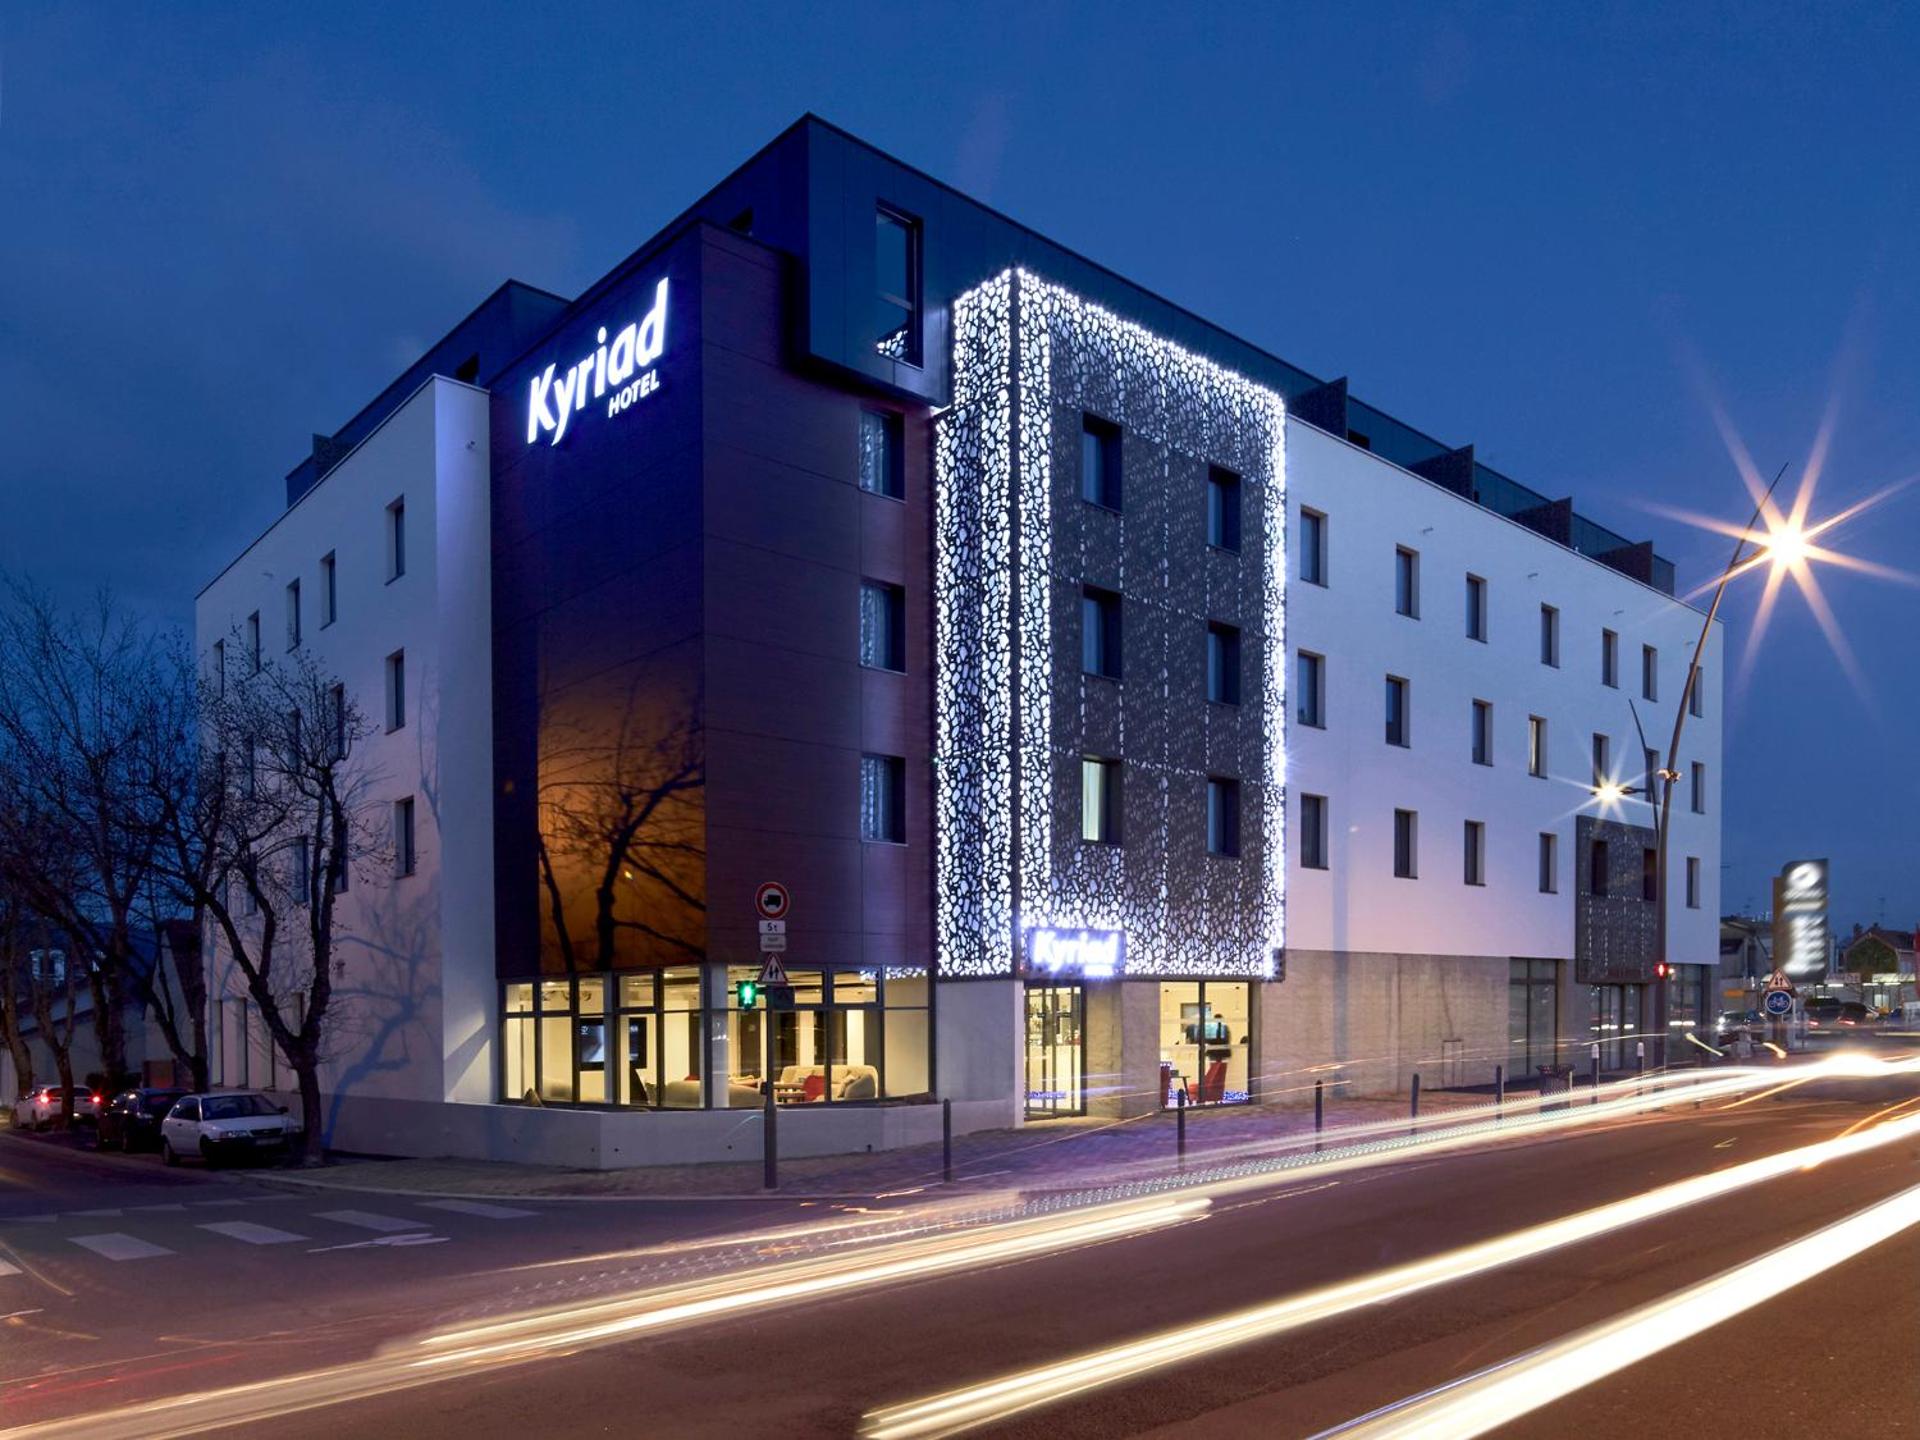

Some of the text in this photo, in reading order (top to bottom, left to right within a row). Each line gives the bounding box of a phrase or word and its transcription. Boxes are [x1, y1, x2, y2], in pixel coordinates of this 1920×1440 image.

[527, 276, 669, 447] Kyriad
[608, 368, 660, 418] HOTEL
[1034, 931, 1118, 971] Kyriad
